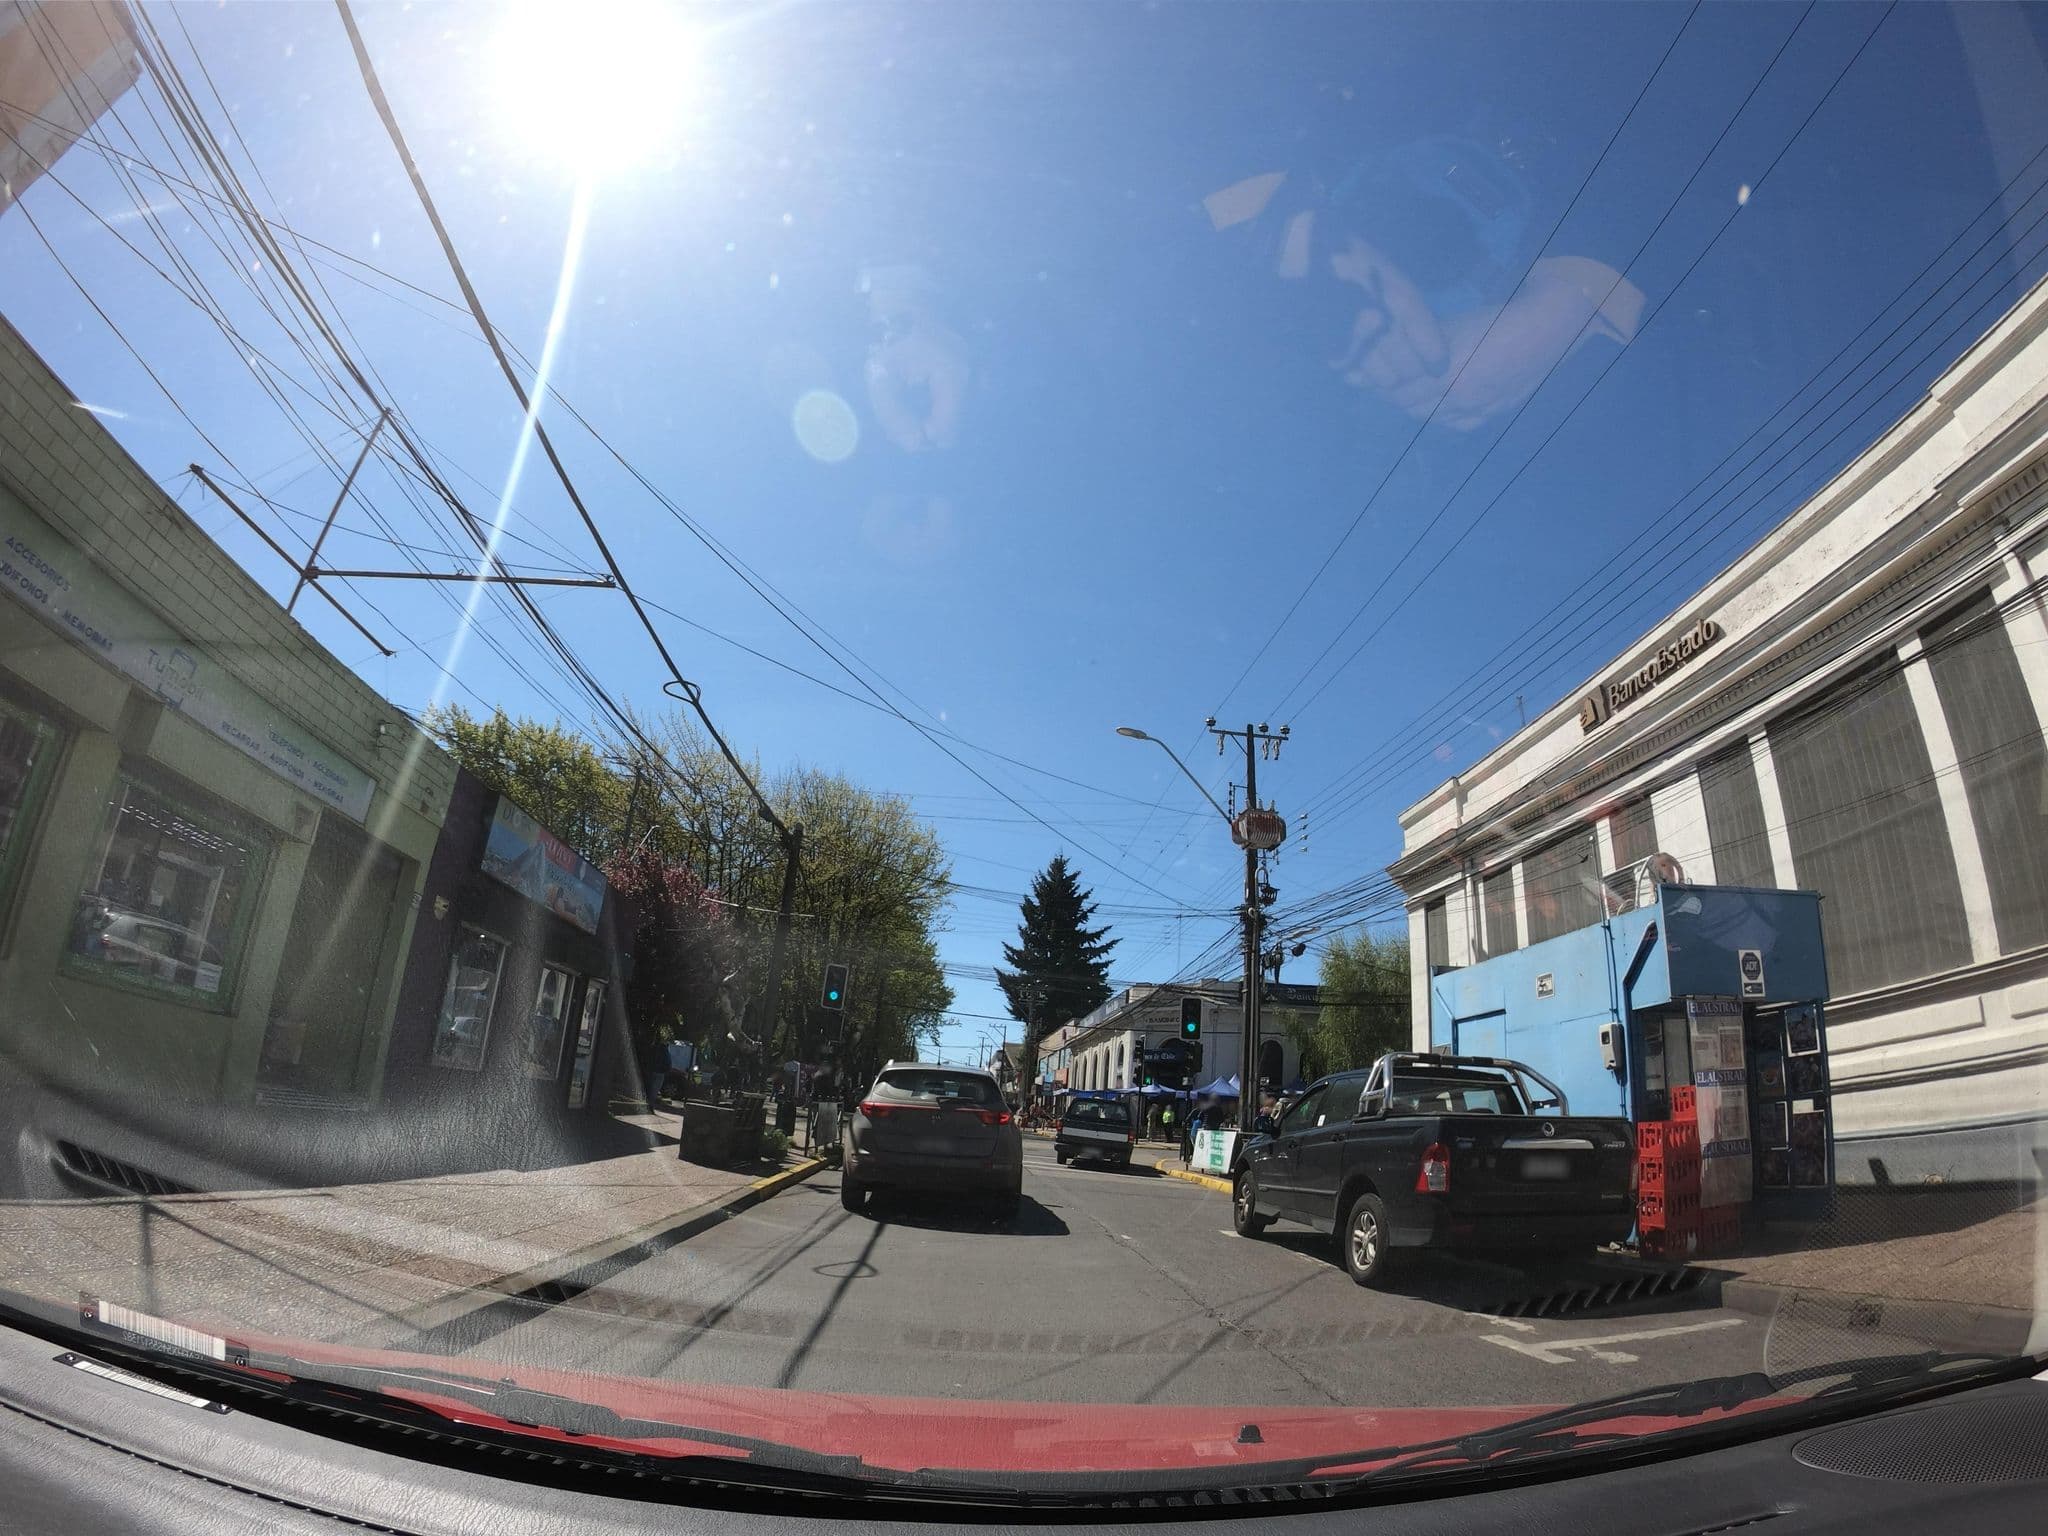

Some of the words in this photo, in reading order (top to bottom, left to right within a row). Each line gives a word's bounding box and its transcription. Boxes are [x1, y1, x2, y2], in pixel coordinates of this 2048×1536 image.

[0, 560, 48, 604] UDIFONOS
[6, 537, 70, 591] ACCESORIOS
[1607, 618, 1718, 709] BancoEstado
[1702, 1001, 1740, 1013] AUSTRAL
[1697, 1072, 1707, 1083] EL
[1707, 1070, 1745, 1083] AUSTRAL
